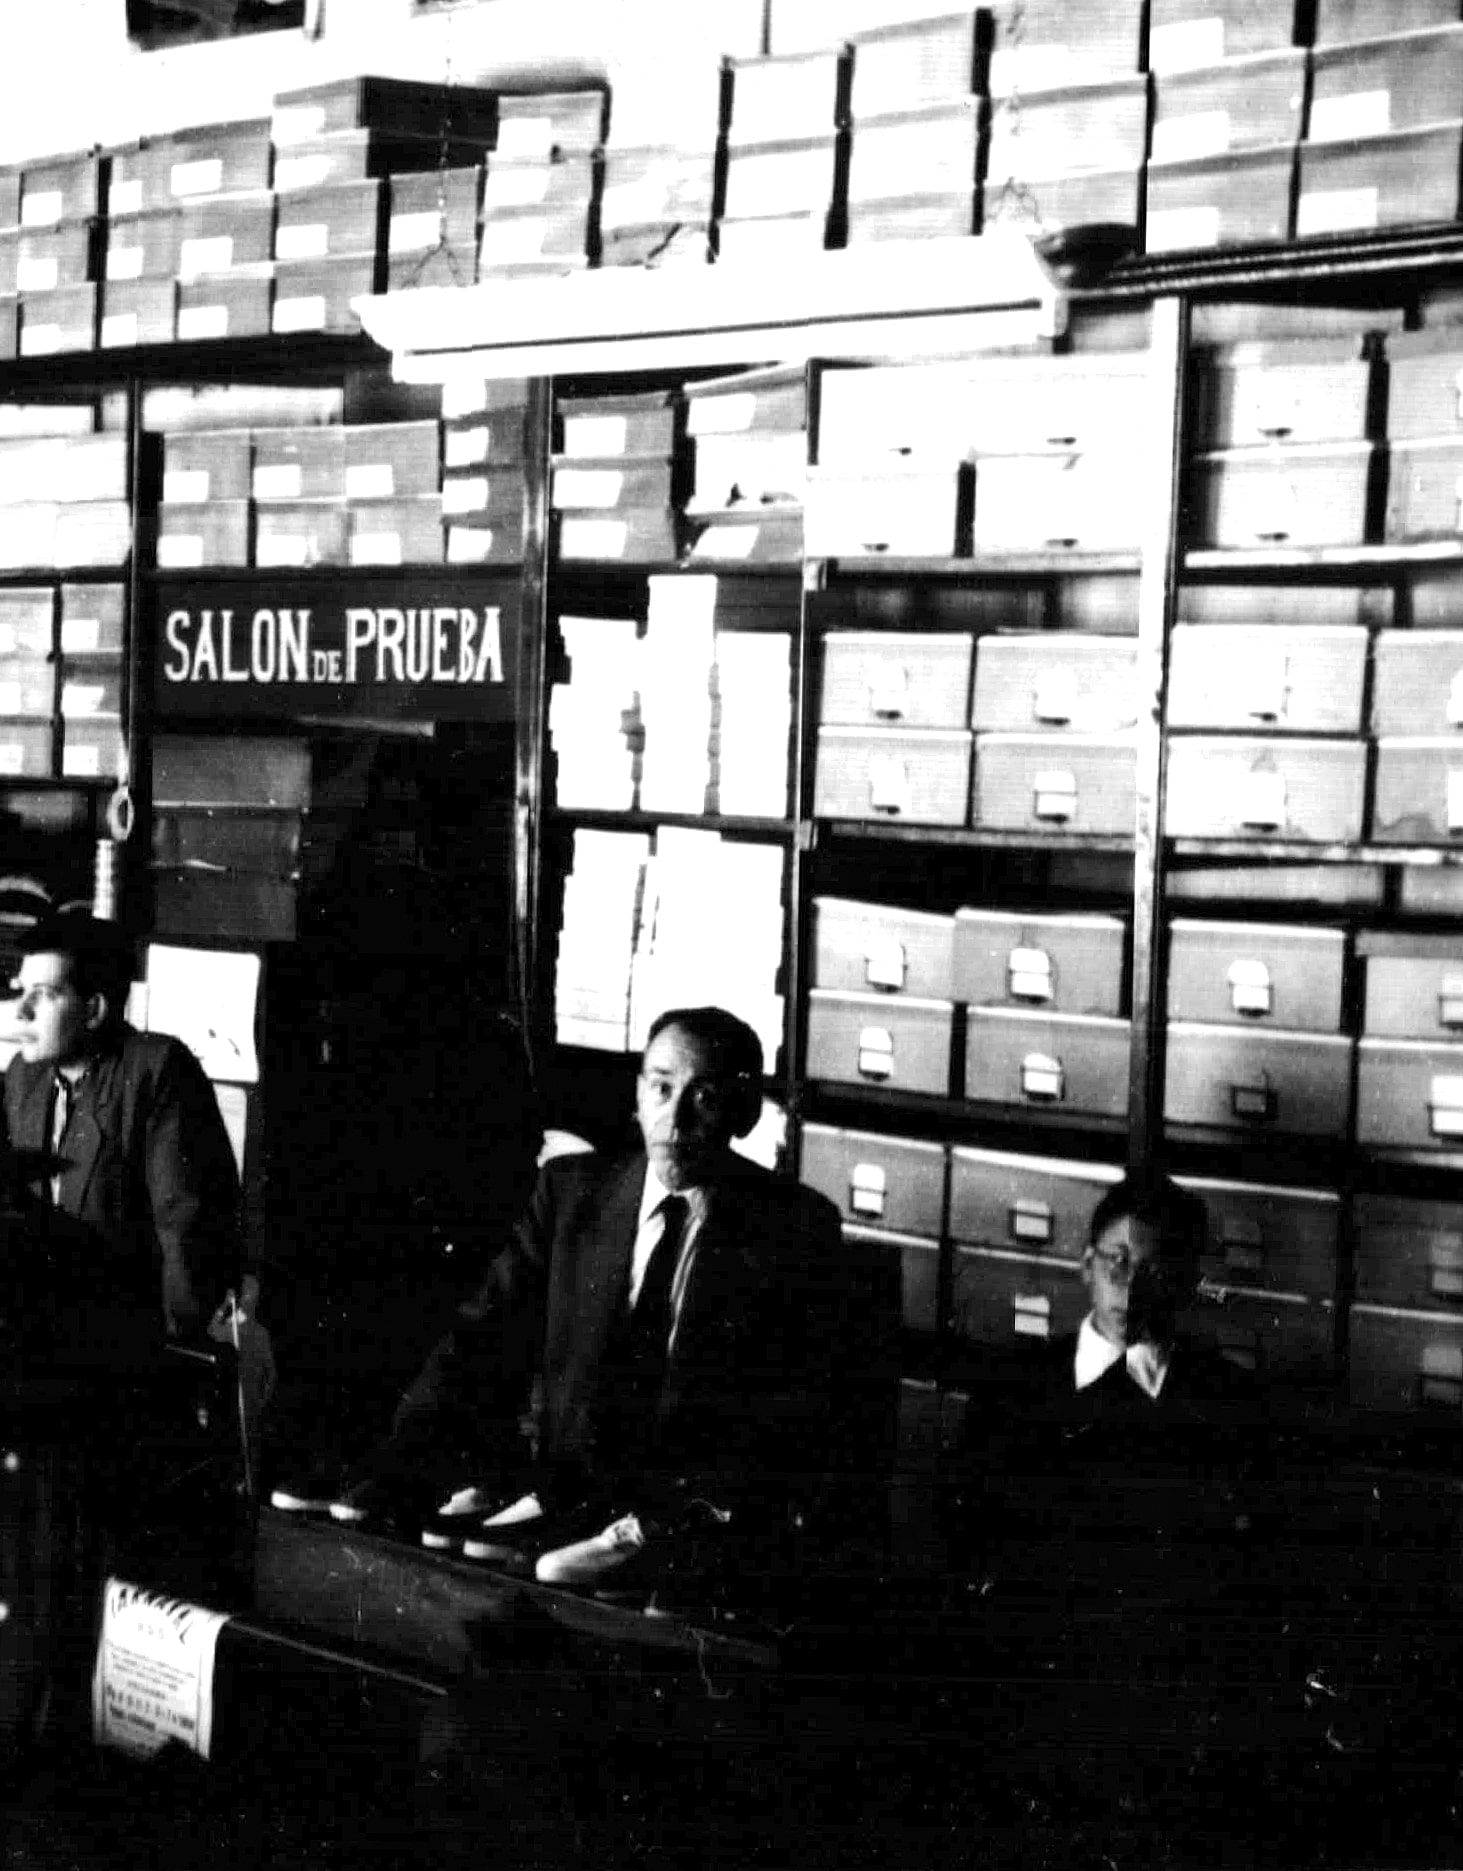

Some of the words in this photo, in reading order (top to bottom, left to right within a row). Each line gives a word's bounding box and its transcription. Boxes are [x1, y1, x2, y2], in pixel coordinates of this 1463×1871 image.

[164, 608, 312, 683] SALON
[312, 649, 343, 684] DE
[344, 605, 505, 684] PRUEBA
